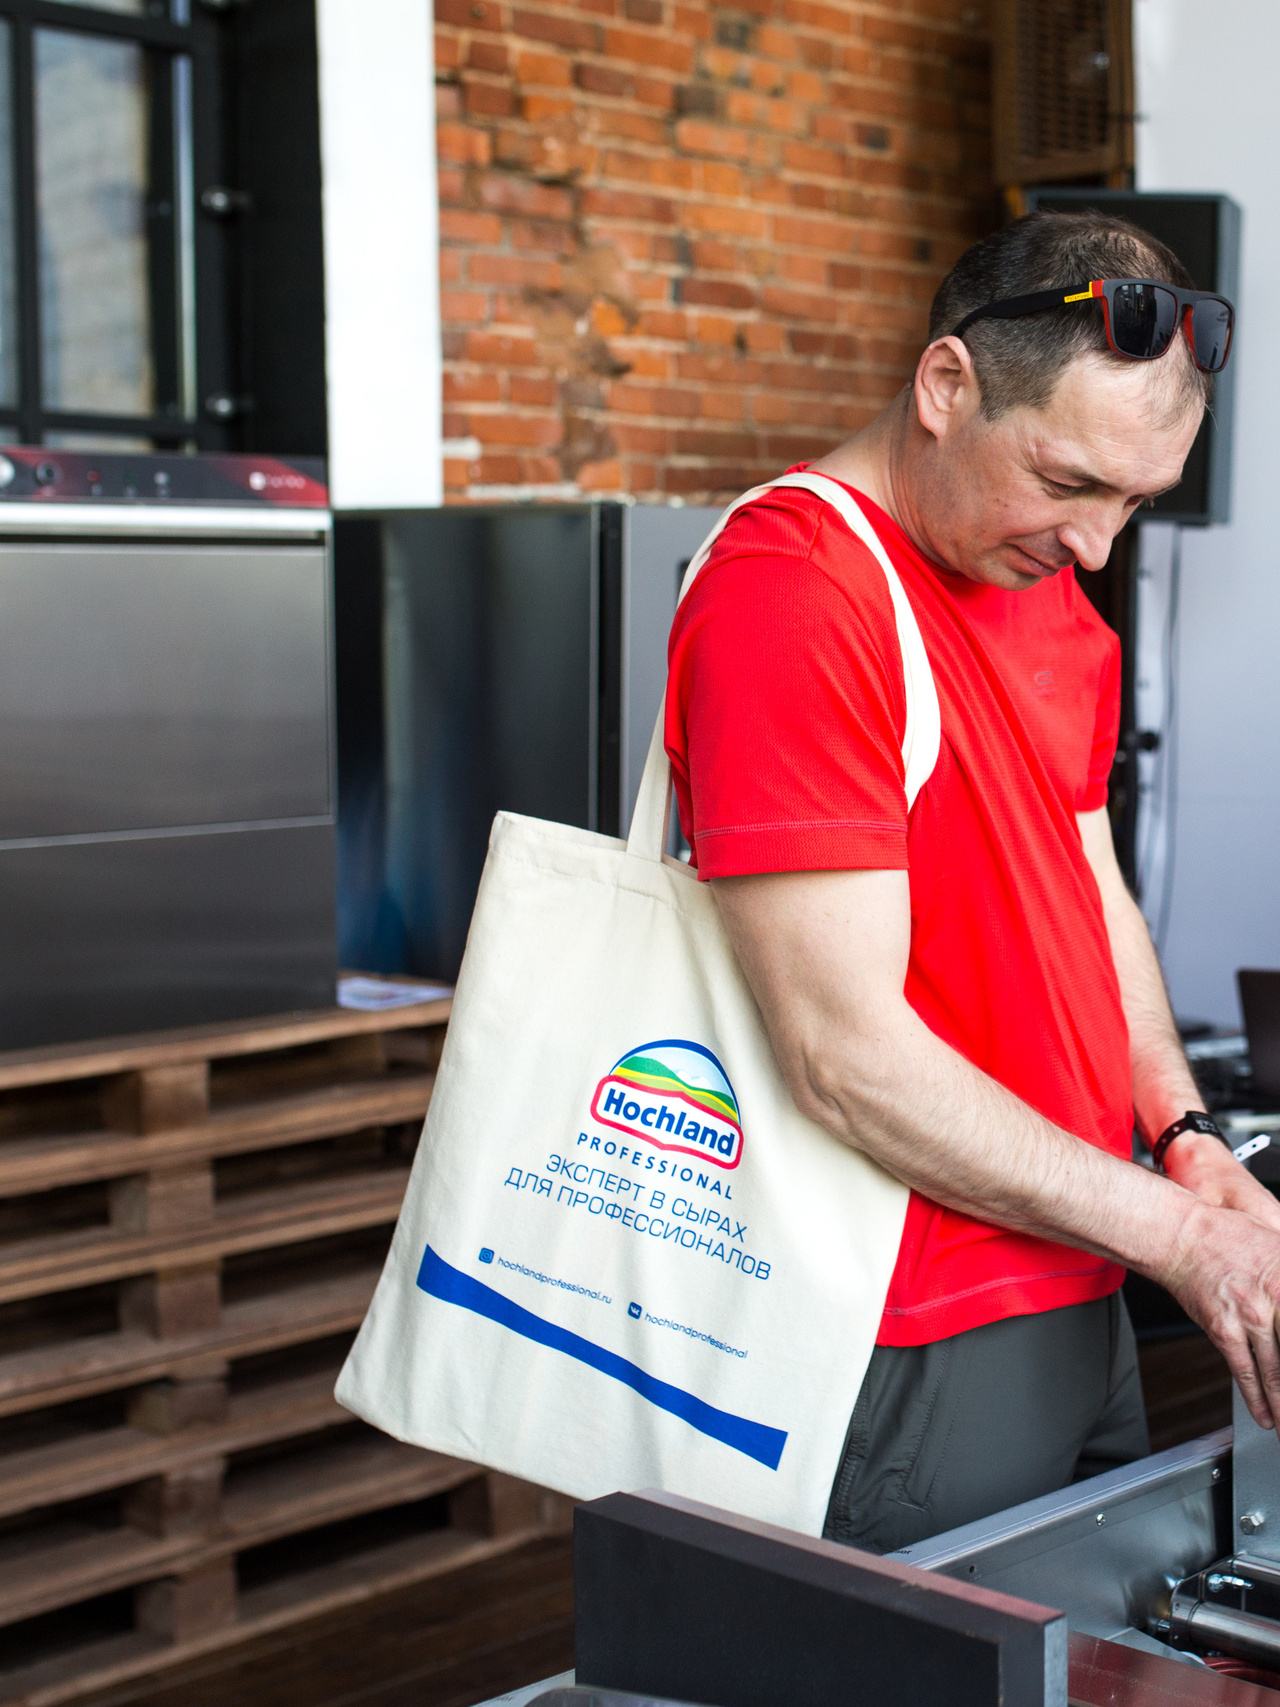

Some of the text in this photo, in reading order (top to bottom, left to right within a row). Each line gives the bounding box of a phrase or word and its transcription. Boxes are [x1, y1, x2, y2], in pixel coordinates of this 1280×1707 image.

[603, 1088, 735, 1157] Hochland
[546, 1153, 748, 1243] ЭКСПЕРТ В СЫРАХ
[577, 1132, 733, 1200] PROFESSIONAL
[504, 1167, 772, 1281] ДЛЯ ПРОФЕССИОНАЛОВ
[497, 1256, 612, 1304] hochlandprofessional.ru
[644, 1312, 748, 1359] hochlandprofessional
